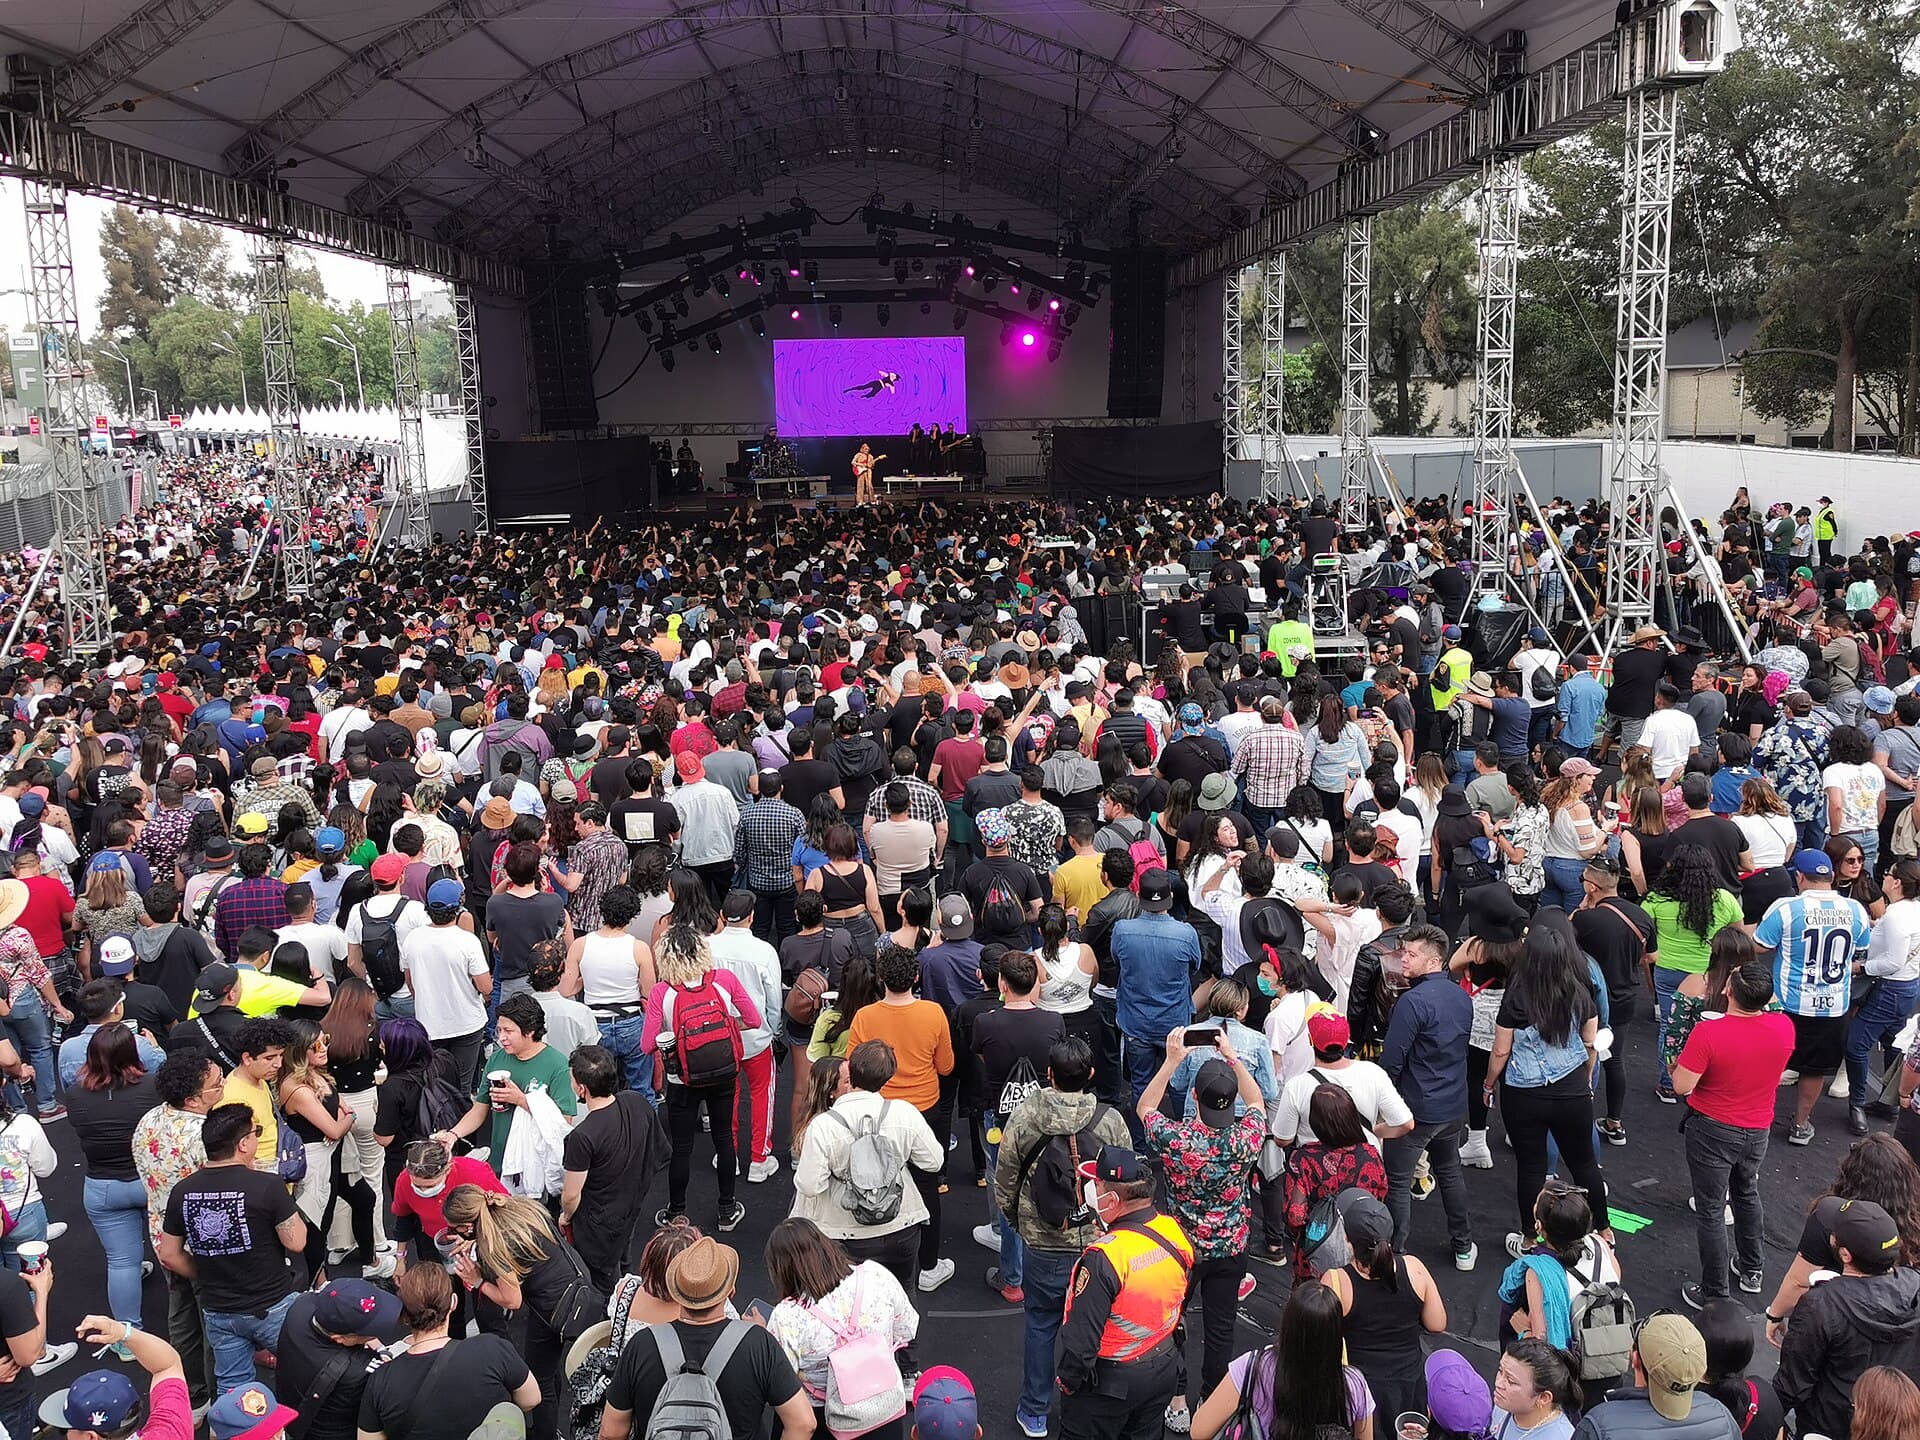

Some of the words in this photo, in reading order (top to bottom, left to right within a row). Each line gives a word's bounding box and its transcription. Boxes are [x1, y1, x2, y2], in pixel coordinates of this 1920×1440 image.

[19, 367, 37, 390] F
[1805, 915, 1853, 926] CADILLACS
[1803, 928, 1851, 985] 10
